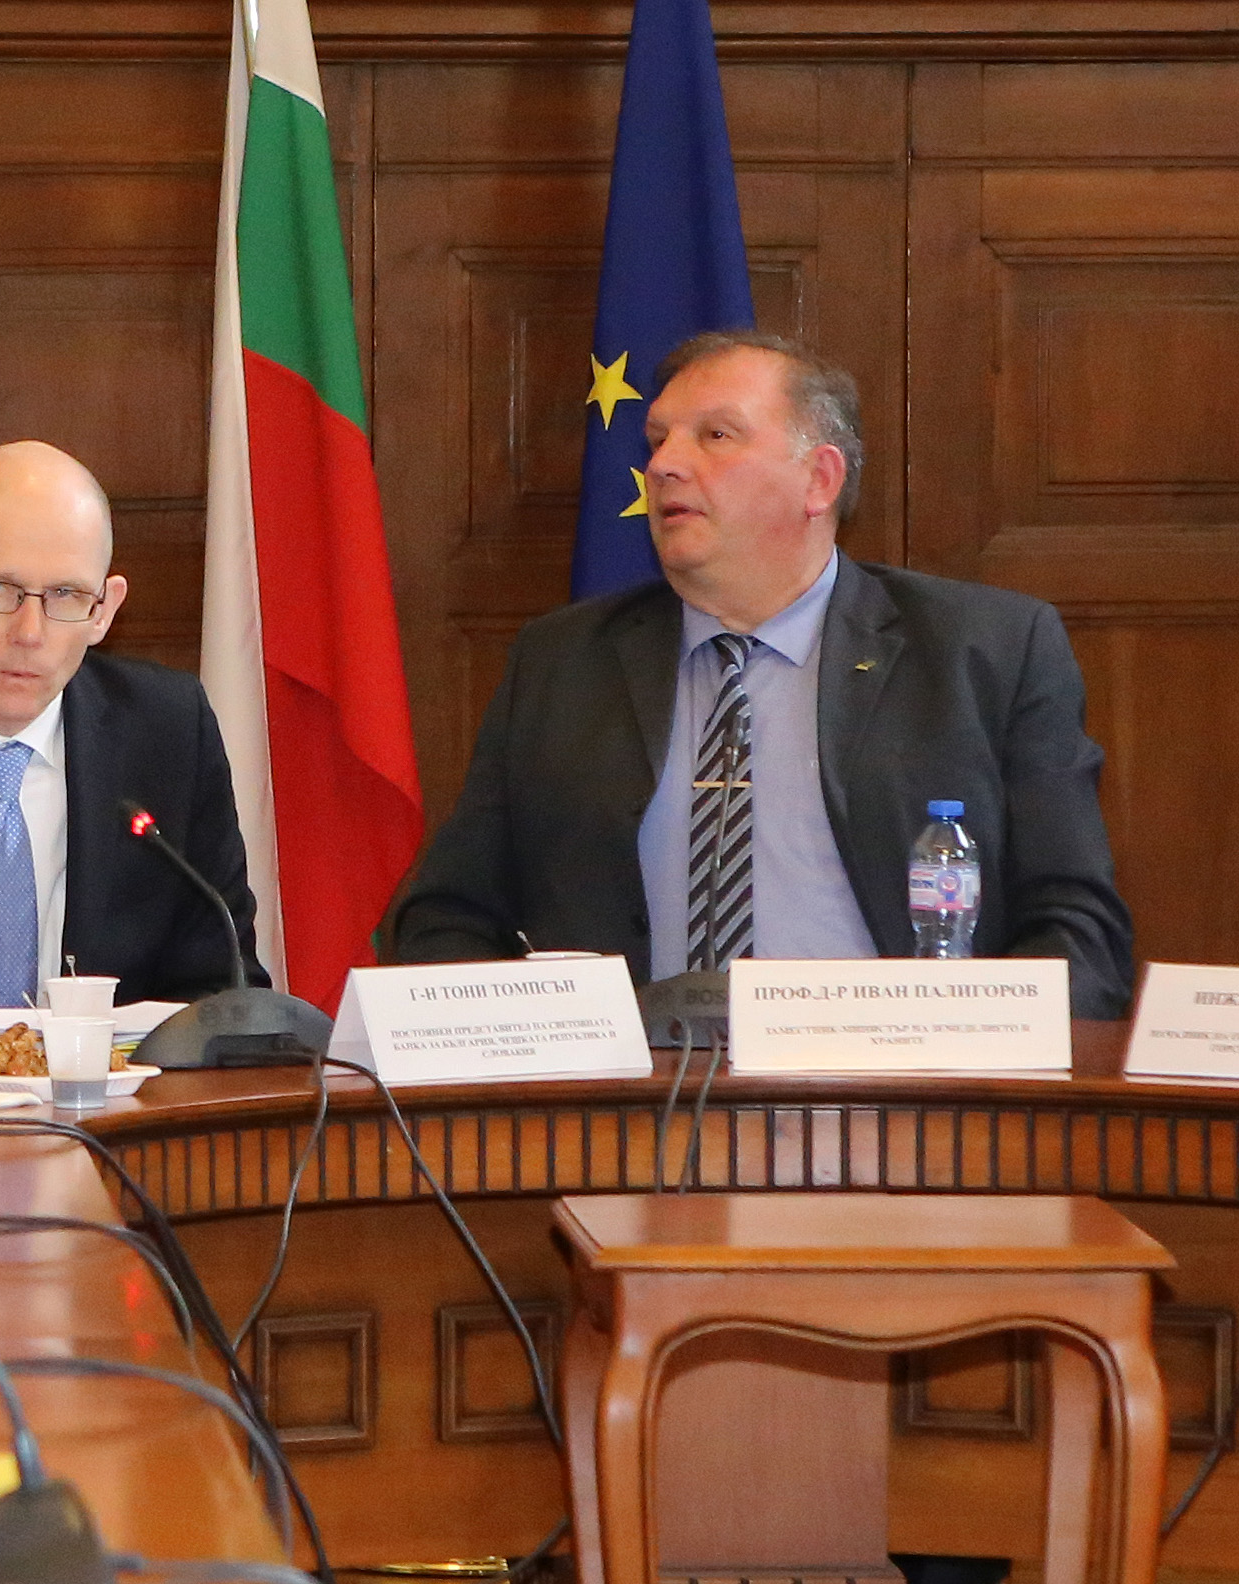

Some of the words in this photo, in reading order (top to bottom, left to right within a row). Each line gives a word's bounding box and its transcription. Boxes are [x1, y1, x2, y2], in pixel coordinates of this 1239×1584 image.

[410, 987, 437, 1001] Г-Н
[440, 984, 487, 1000] ТОНИ
[491, 979, 576, 998] ТОМПСЪН
[852, 985, 909, 999] ИВАН
[914, 984, 1039, 999] ПАЛИГОРОВ
